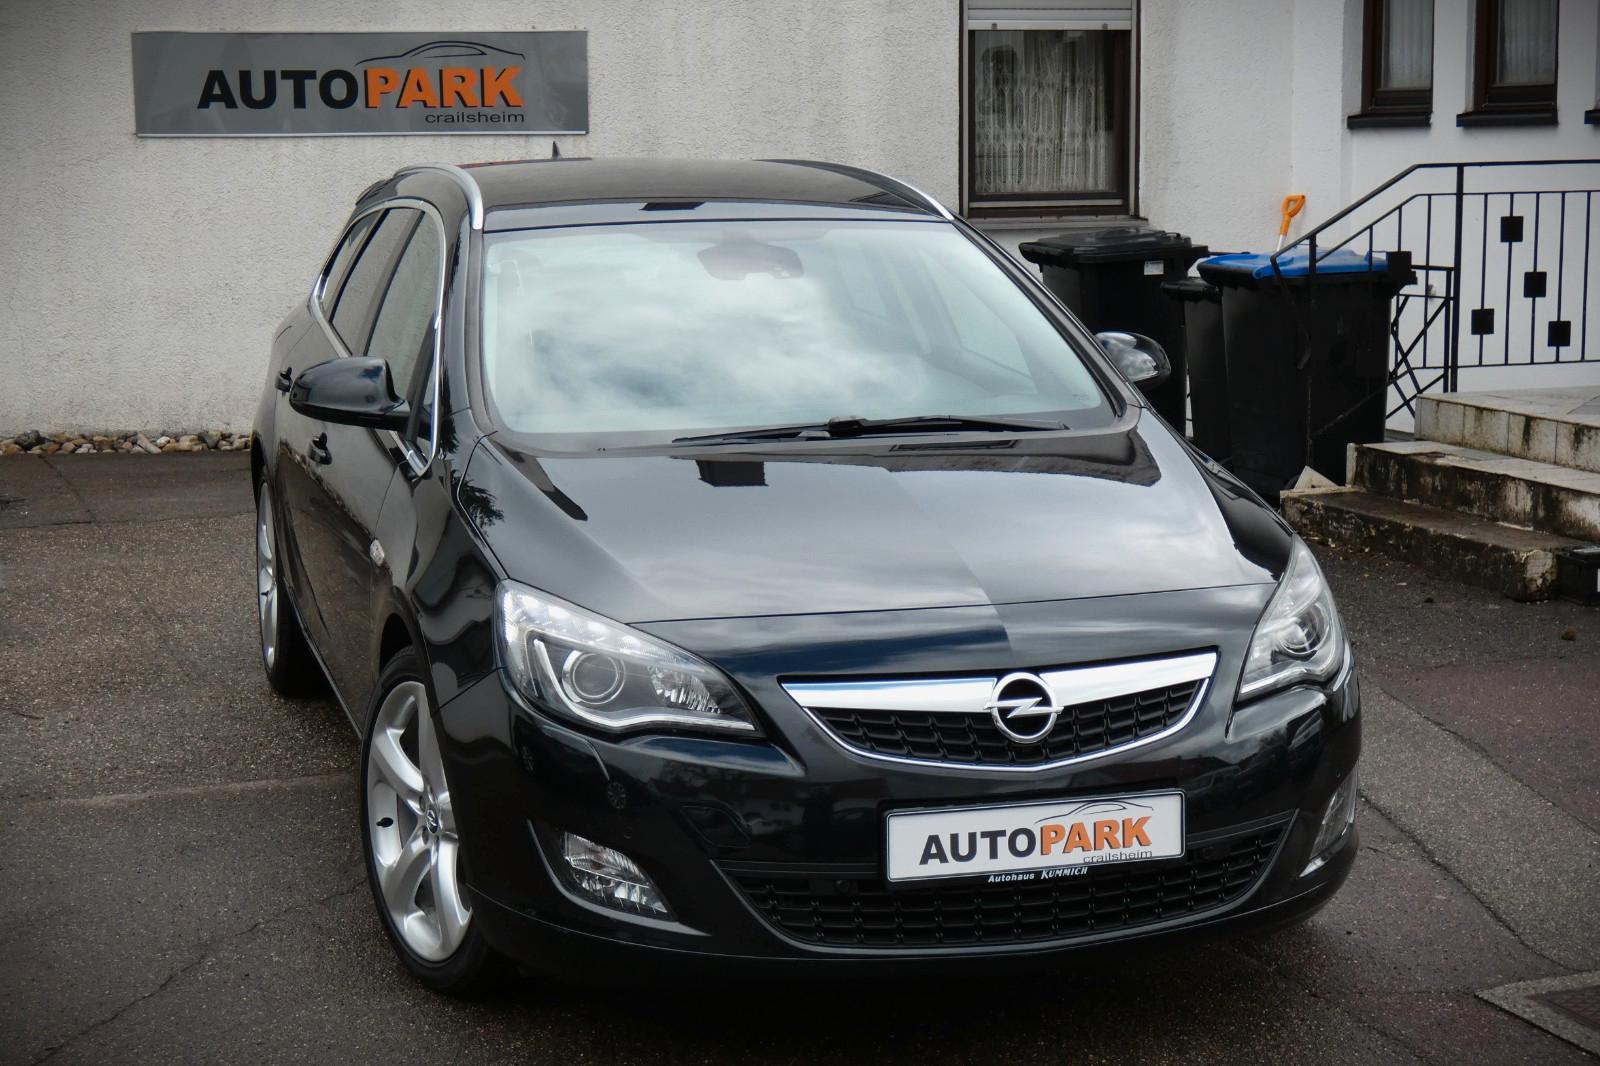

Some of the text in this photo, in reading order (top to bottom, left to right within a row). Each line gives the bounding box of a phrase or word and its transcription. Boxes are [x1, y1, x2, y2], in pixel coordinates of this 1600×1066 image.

[196, 66, 525, 110] AUTOPARK
[424, 111, 525, 124] crailsheim
[918, 815, 1152, 866] AUTOPARK
[1082, 850, 1153, 864] crailsheim
[987, 873, 1035, 883] Autohaus
